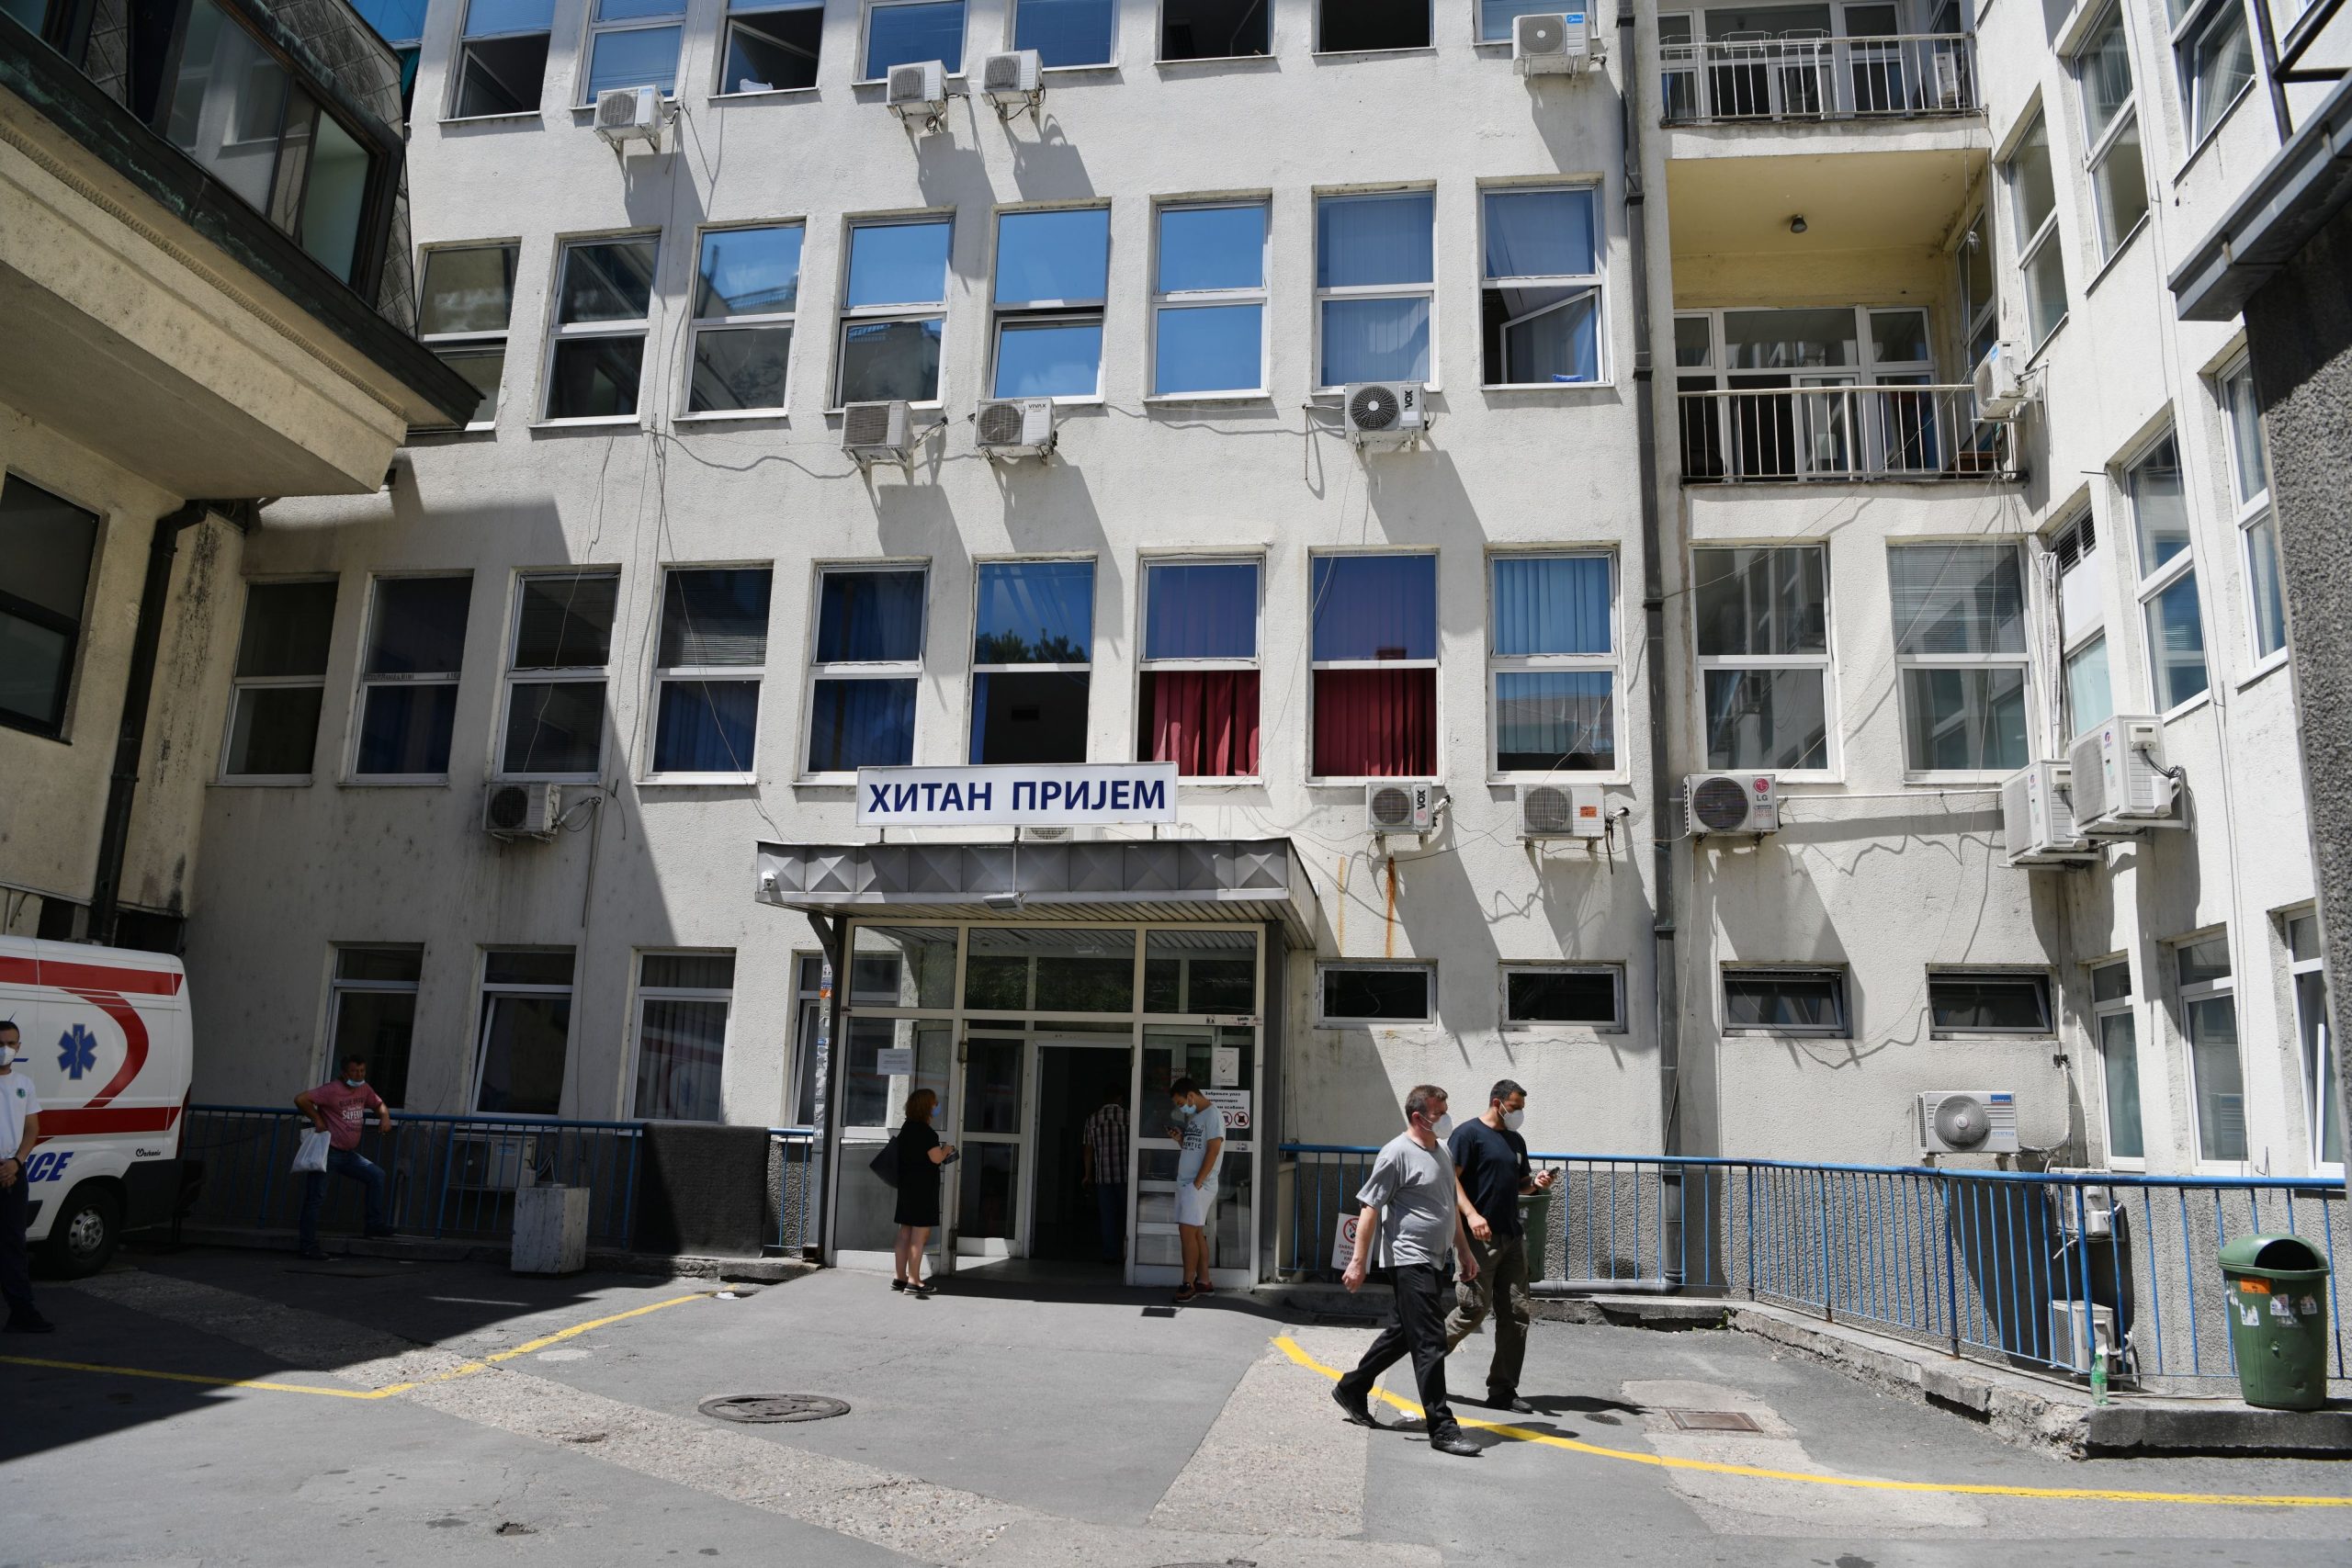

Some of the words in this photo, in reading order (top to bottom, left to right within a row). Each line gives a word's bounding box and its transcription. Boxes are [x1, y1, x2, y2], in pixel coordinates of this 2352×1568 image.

[1405, 390, 1413, 408] VOX
[867, 782, 992, 813] ХИТАН
[1012, 780, 1165, 810] ПРИЈЕМ
[1417, 790, 1426, 810] VOX
